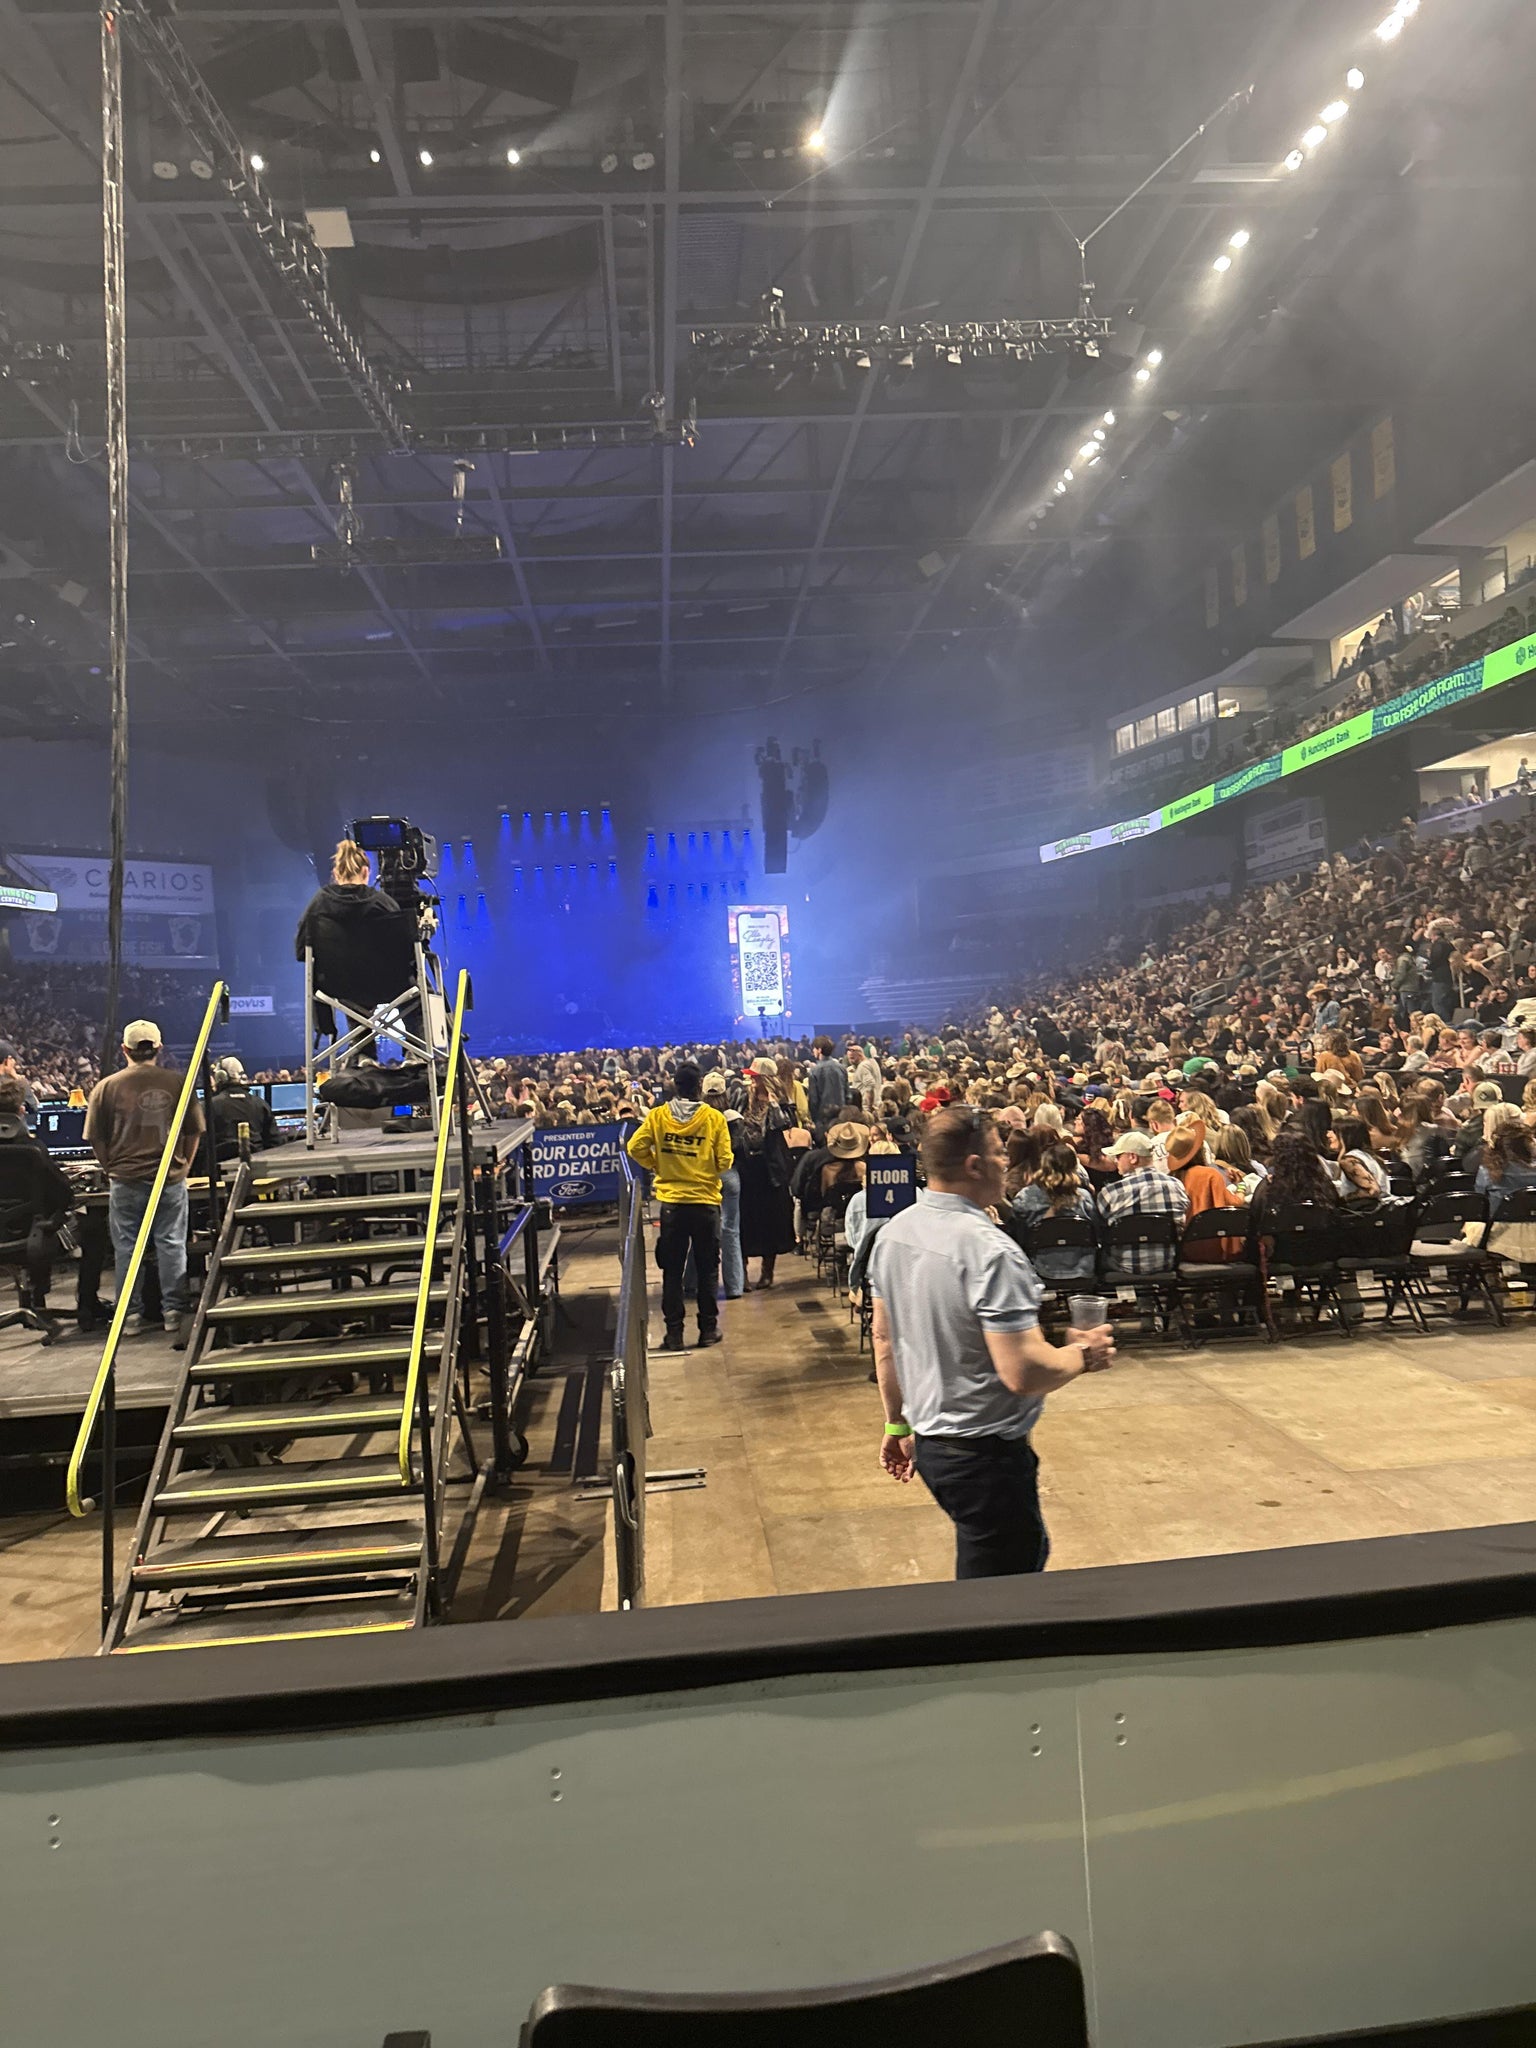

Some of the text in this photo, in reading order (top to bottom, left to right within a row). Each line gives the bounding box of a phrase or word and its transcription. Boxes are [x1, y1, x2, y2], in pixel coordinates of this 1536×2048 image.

[1383, 712, 1399, 727] OUR
[1419, 686, 1437, 708] OUR
[1437, 673, 1465, 695] FIGHT!
[1308, 737, 1335, 756] Huntington
[1336, 729, 1349, 743] Bank
[85, 868, 204, 892] CARIOS
[543, 1133, 585, 1142] PRESENTED
[664, 1132, 706, 1146] BEST
[528, 1142, 620, 1162] OUR LOCAL
[520, 1163, 556, 1179] RD
[870, 1169, 909, 1185] FLOOR
[558, 1183, 586, 1196] Ford
[885, 1189, 894, 1204] 4
